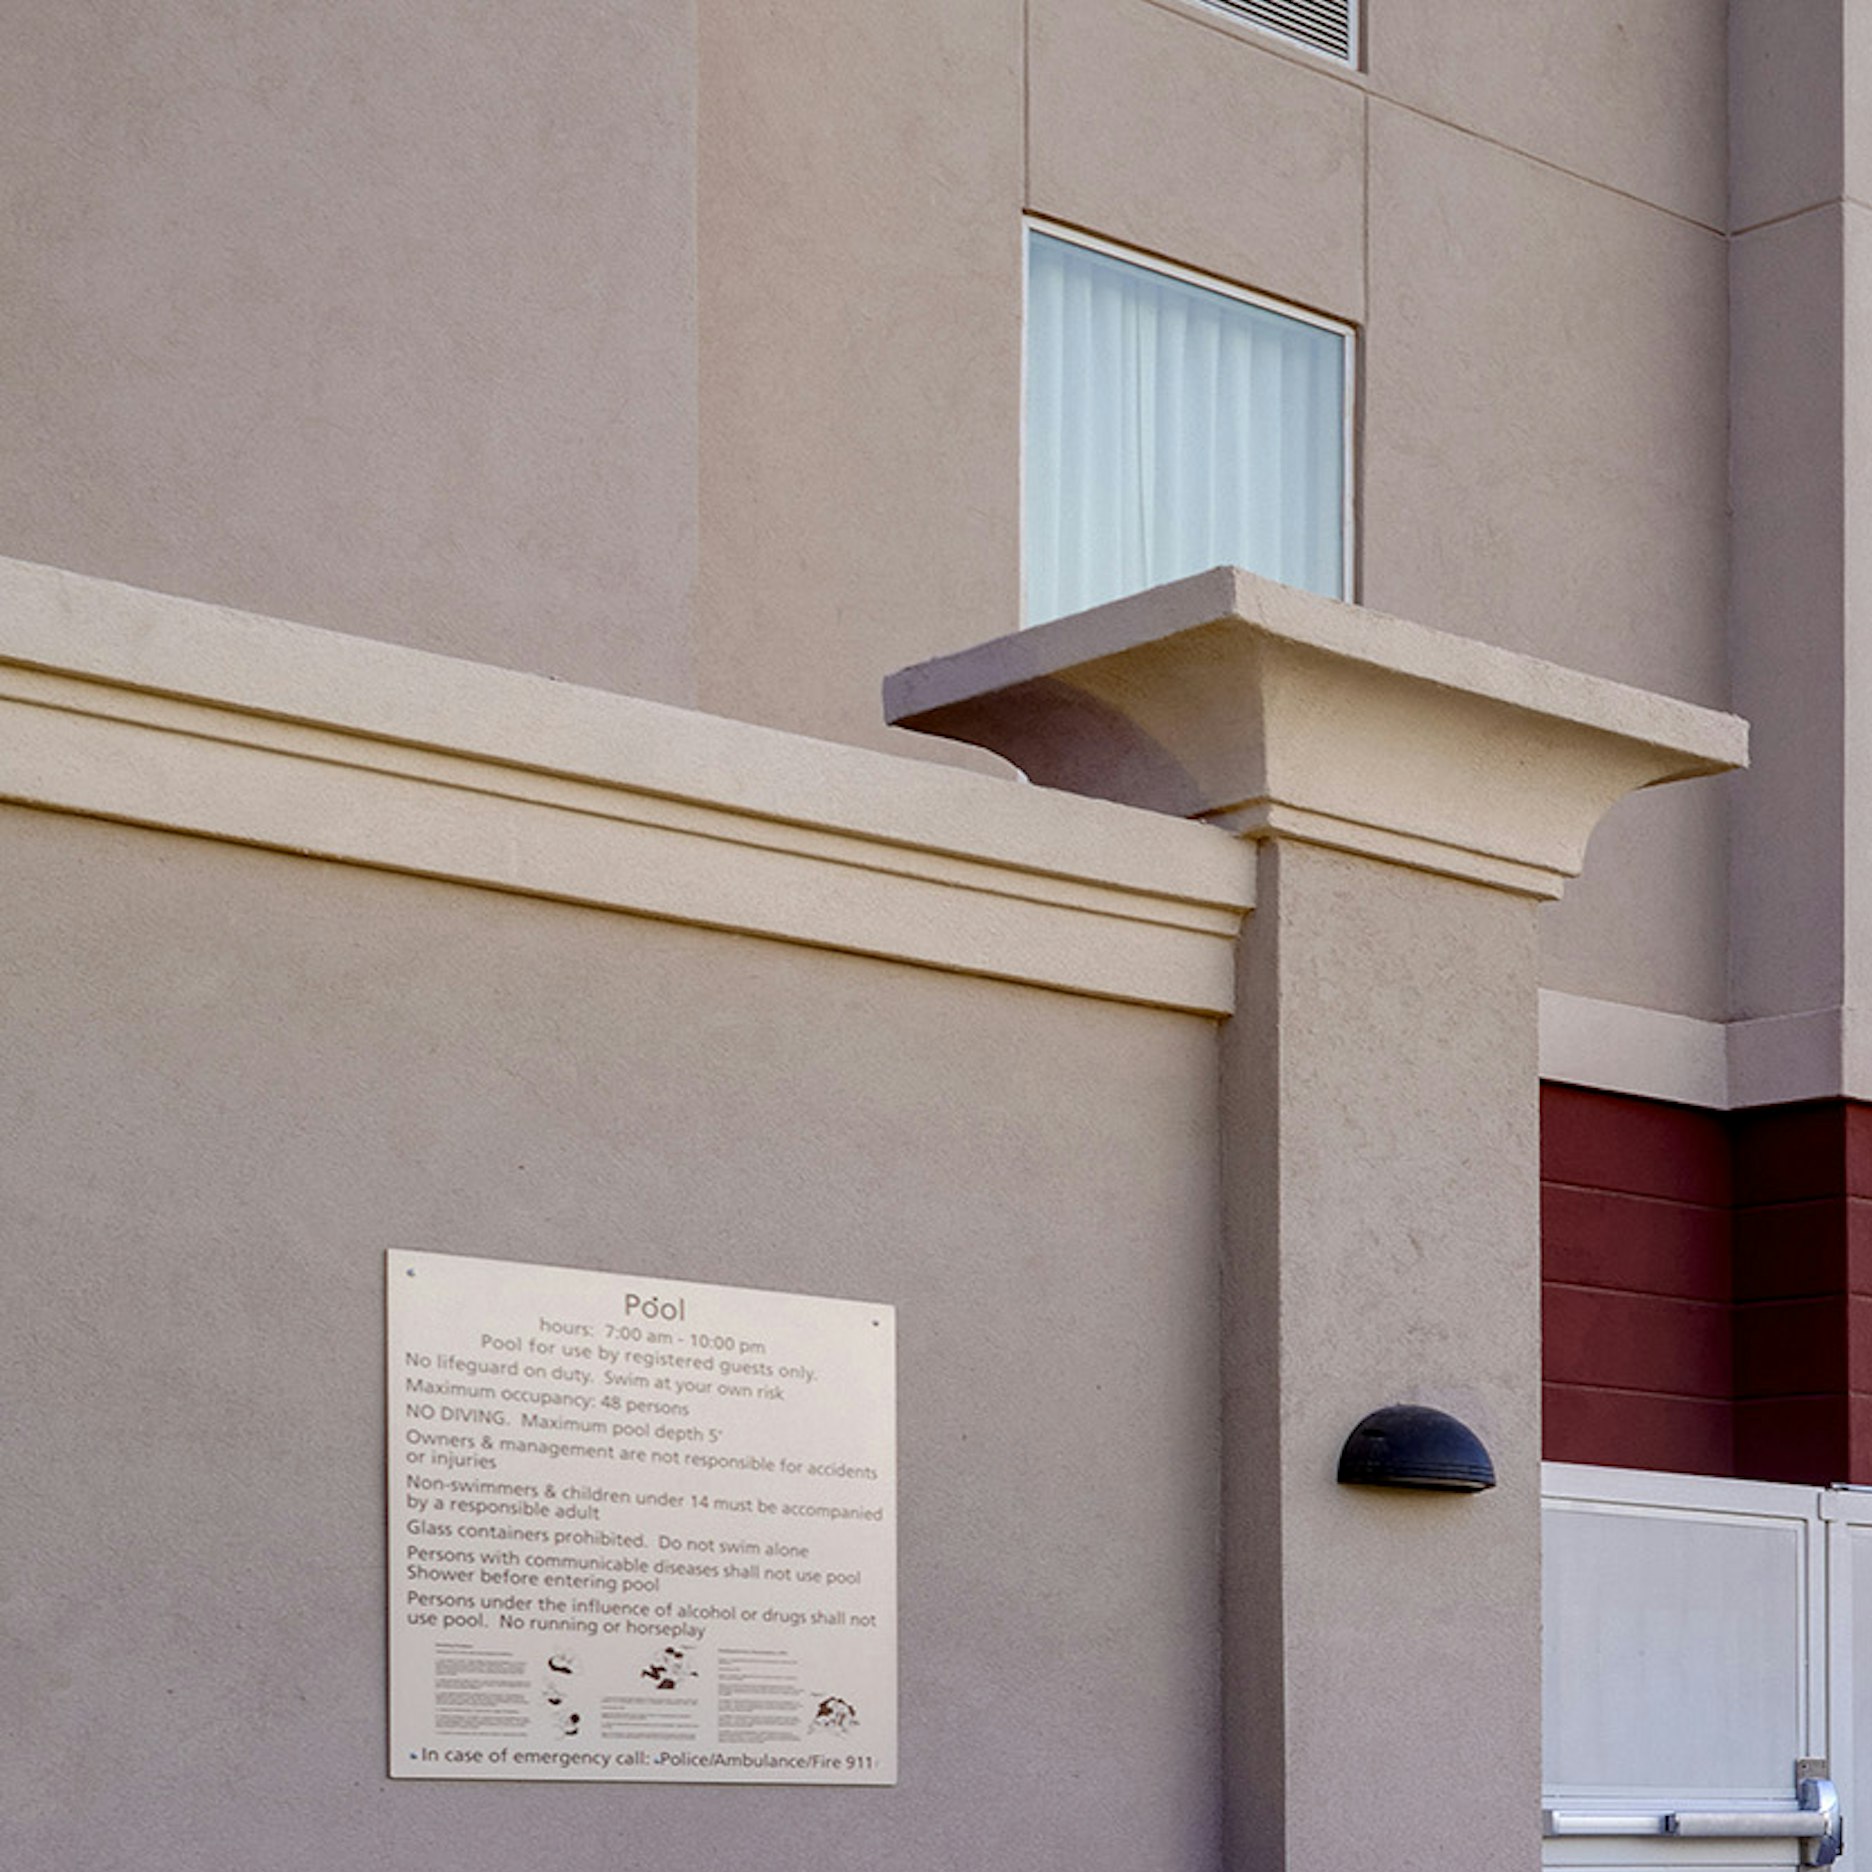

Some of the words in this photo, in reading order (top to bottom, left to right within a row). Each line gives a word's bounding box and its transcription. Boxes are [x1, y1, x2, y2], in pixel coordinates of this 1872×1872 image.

[623, 1292, 685, 1322] Pool
[538, 1316, 594, 1337] hours:
[604, 1323, 642, 1342] 7:00
[645, 1331, 673, 1344] am
[689, 1332, 736, 1351] 10:00
[738, 1340, 766, 1354] pm
[404, 1350, 432, 1369] No
[436, 1353, 518, 1376] lifeguard
[522, 1364, 547, 1378] on
[550, 1365, 593, 1386] duty.
[603, 1368, 650, 1387] Swim
[653, 1376, 671, 1390] at
[674, 1379, 712, 1395] your
[716, 1382, 753, 1397] own
[756, 1385, 784, 1400] risk
[480, 1332, 522, 1352] Pool
[527, 1337, 555, 1355] for
[561, 1345, 592, 1360] use
[597, 1344, 620, 1365] by
[624, 1350, 714, 1371] registered
[718, 1359, 774, 1377] guests
[777, 1364, 817, 1384] only.
[405, 1376, 496, 1399] Maximum
[499, 1388, 595, 1411] occupancy:
[599, 1394, 622, 1411] 48
[625, 1399, 690, 1416] persons
[405, 1402, 436, 1420] NO
[439, 1404, 510, 1426] DIVING.
[520, 1411, 607, 1433] Maximum
[611, 1422, 650, 1437] pool
[653, 1424, 704, 1442] depth
[404, 1427, 475, 1449] Owners
[479, 1433, 494, 1450] &
[498, 1438, 614, 1459] management
[618, 1448, 647, 1462] are
[650, 1450, 680, 1465] not
[683, 1453, 775, 1472] responsible
[778, 1457, 803, 1474] for
[806, 1462, 878, 1480] accidents
[405, 1450, 426, 1464] or
[430, 1453, 497, 1470] injuries
[405, 1472, 539, 1497] Non-swimmers
[542, 1482, 557, 1499] &
[560, 1484, 631, 1504] children
[634, 1491, 684, 1508] under
[690, 1494, 709, 1509] 14
[712, 1498, 753, 1513] must
[756, 1498, 778, 1515] be
[780, 1503, 883, 1522] accompanied
[405, 1492, 429, 1512] by
[432, 1497, 445, 1511] a
[449, 1499, 551, 1518] responsible
[553, 1503, 600, 1521] adult
[405, 1517, 453, 1537] Glass
[455, 1524, 550, 1543] containers
[553, 1528, 648, 1549] prohibited.
[657, 1533, 683, 1551] Do
[686, 1538, 715, 1553] not
[717, 1541, 761, 1554] swim
[763, 1541, 809, 1558] alone
[405, 1543, 476, 1564] Persons
[478, 1549, 520, 1565] with
[523, 1553, 649, 1574] communicable
[652, 1558, 720, 1578] diseases
[722, 1562, 760, 1579] shall
[763, 1567, 791, 1582] not
[795, 1570, 822, 1583] use
[825, 1570, 861, 1586] pool
[405, 1562, 475, 1583] Shower
[479, 1567, 539, 1587] before
[542, 1573, 618, 1593] entering
[621, 1576, 660, 1593] pool
[405, 1612, 438, 1627] use
[441, 1611, 489, 1630] pool.
[498, 1613, 525, 1630] No
[528, 1617, 599, 1637] running
[601, 1620, 621, 1634] or
[625, 1618, 706, 1641] horseplay
[406, 1588, 476, 1609] Persons
[479, 1594, 533, 1611] under
[536, 1596, 567, 1613] the
[570, 1597, 650, 1617] influence
[653, 1601, 673, 1618] of
[676, 1602, 736, 1621] alcohol
[739, 1609, 758, 1622] or
[760, 1607, 807, 1626] drugs
[809, 1609, 846, 1625] shall
[849, 1614, 877, 1627] not
[420, 1745, 439, 1762] In
[443, 1749, 484, 1764] case
[486, 1746, 508, 1764] of
[511, 1750, 612, 1769] emergency
[614, 1749, 650, 1766] call:
[659, 1750, 842, 1770] Police/Ambulance/Fire
[844, 1754, 872, 1770] 911
